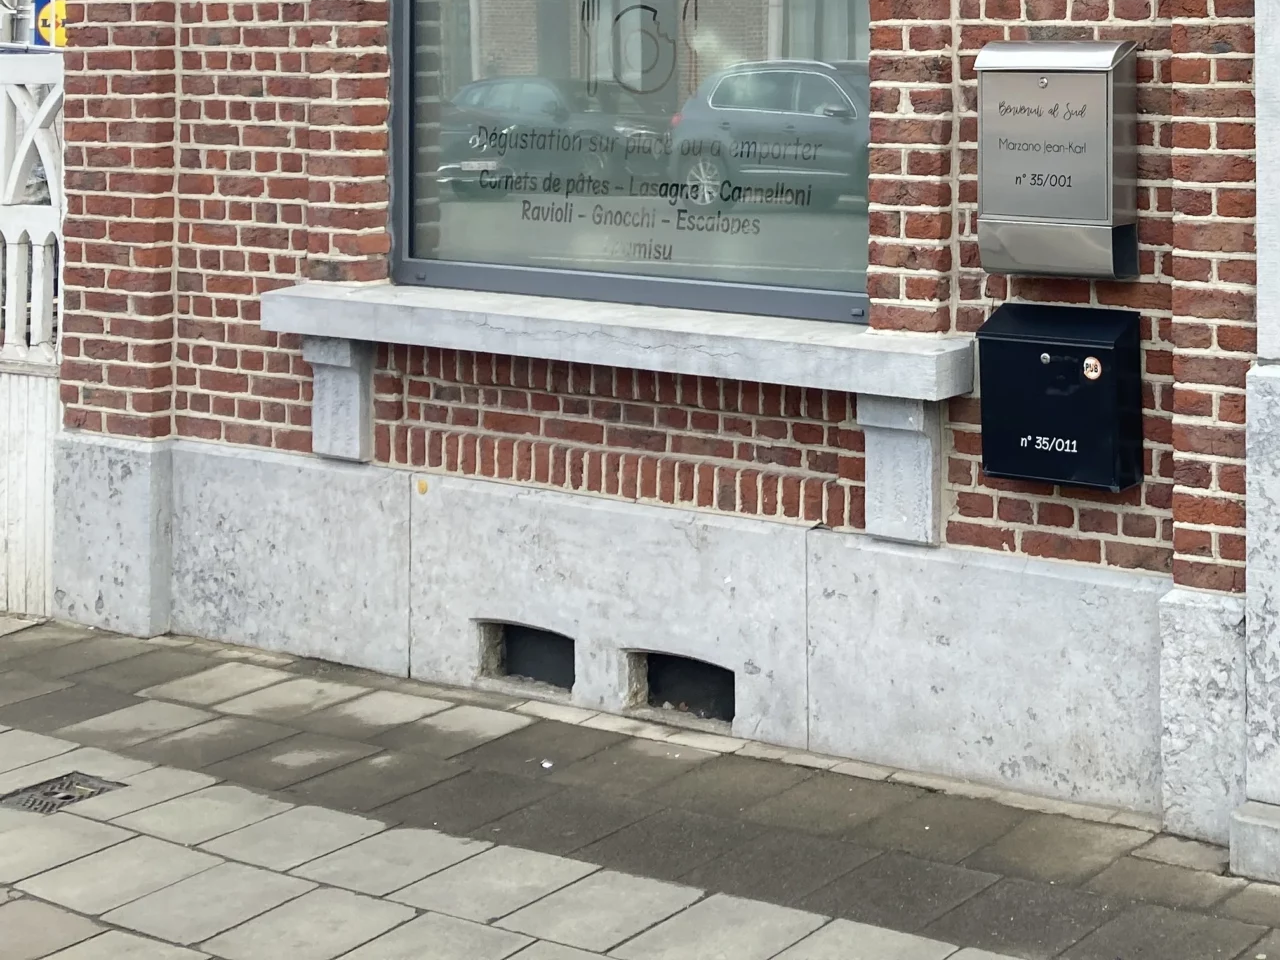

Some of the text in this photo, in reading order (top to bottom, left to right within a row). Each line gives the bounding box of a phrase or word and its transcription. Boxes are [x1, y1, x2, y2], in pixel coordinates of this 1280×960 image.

[1048, 103, 1059, 118] al
[1063, 102, 1087, 120] Sud
[478, 126, 582, 156] Dégustation
[588, 137, 615, 152] sur
[681, 138, 701, 157] ou
[729, 134, 823, 163] emporter
[999, 138, 1086, 154] Marzano Jean-Karl
[478, 169, 537, 192] Cornets
[542, 171, 561, 191] de
[566, 174, 608, 196] pâtes
[719, 180, 812, 207] Cannelloni
[1015, 173, 1072, 187] n° 35/001
[521, 200, 760, 235] Ravioli Gnocchi Escalopes
[1085, 363, 1098, 372] PUB
[1021, 435, 1077, 452] n° 35/011
